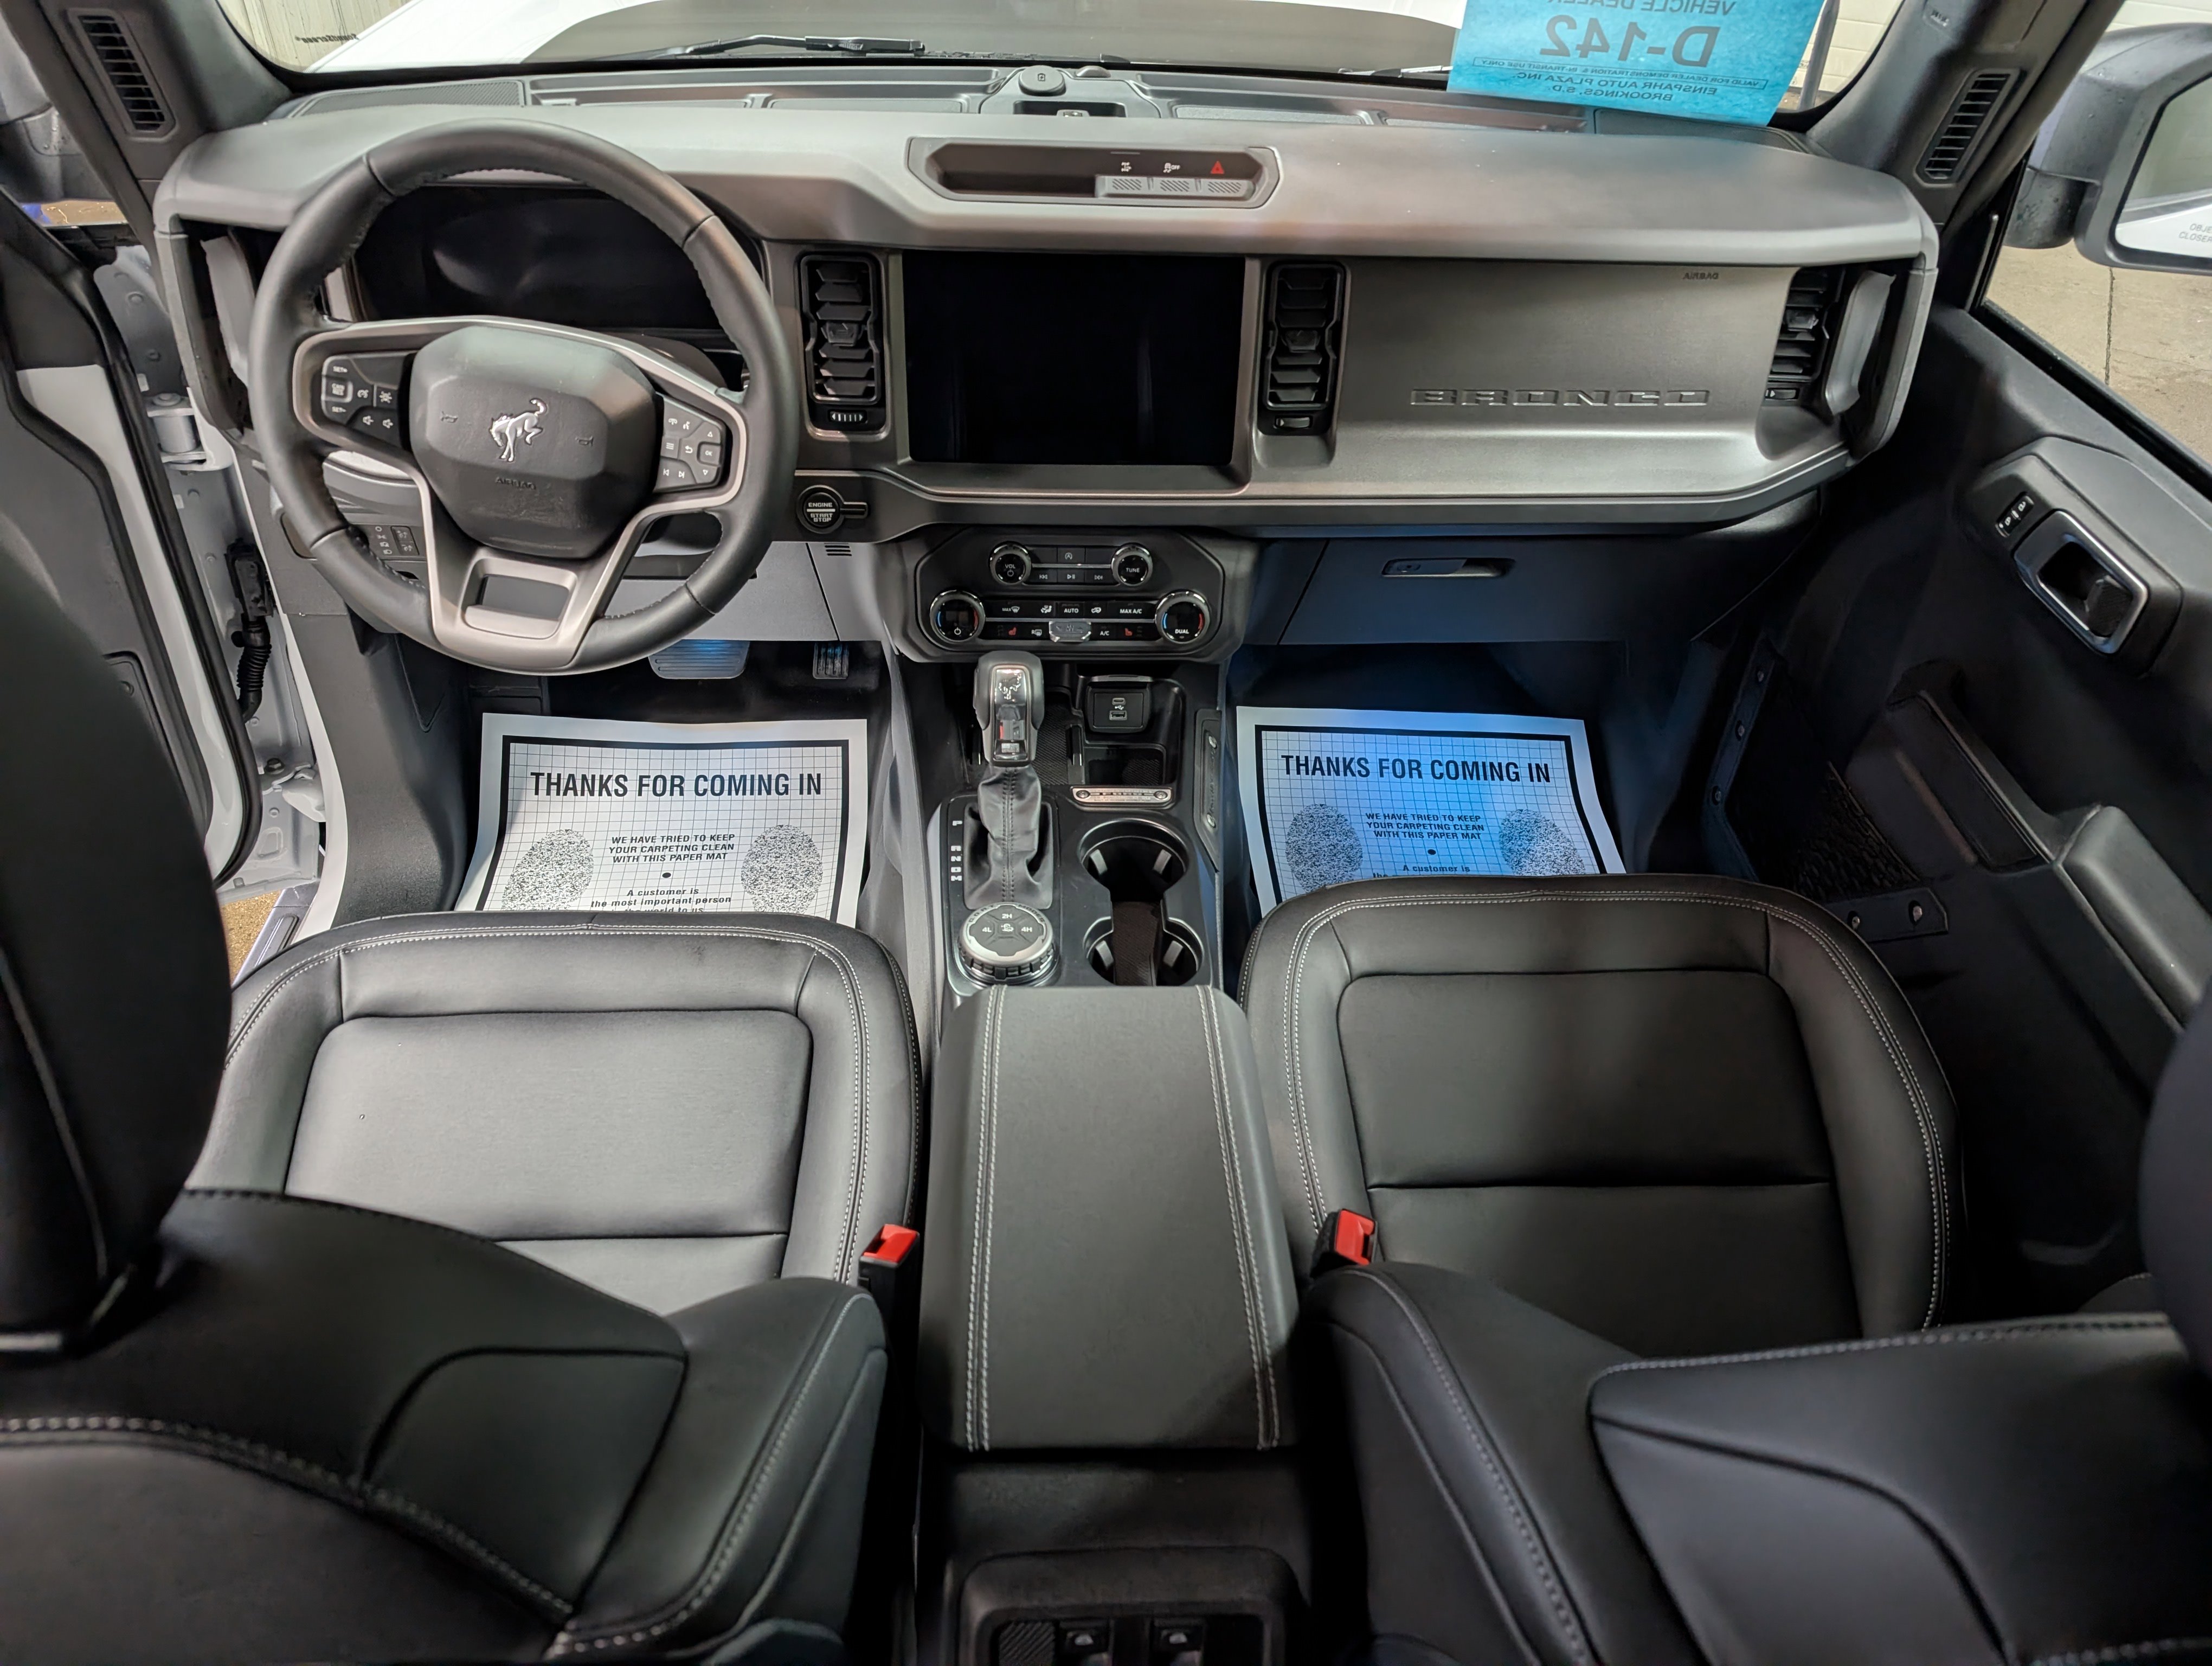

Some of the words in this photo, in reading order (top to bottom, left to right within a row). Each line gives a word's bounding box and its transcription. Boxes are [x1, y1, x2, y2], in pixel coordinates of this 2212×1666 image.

[1411, 389, 1710, 406] BRONCO
[1281, 755, 1370, 778] THANKS
[1379, 758, 1423, 779] FOR
[1431, 760, 1519, 782] COMING
[1529, 762, 1551, 783] IN
[531, 772, 628, 797] THANKS
[638, 775, 685, 797] FOR
[695, 773, 789, 796] COMING
[799, 773, 822, 795] IN
[641, 844, 698, 853] CARPETING
[638, 888, 687, 896] customer
[641, 897, 692, 906] important
[695, 896, 732, 906] person
